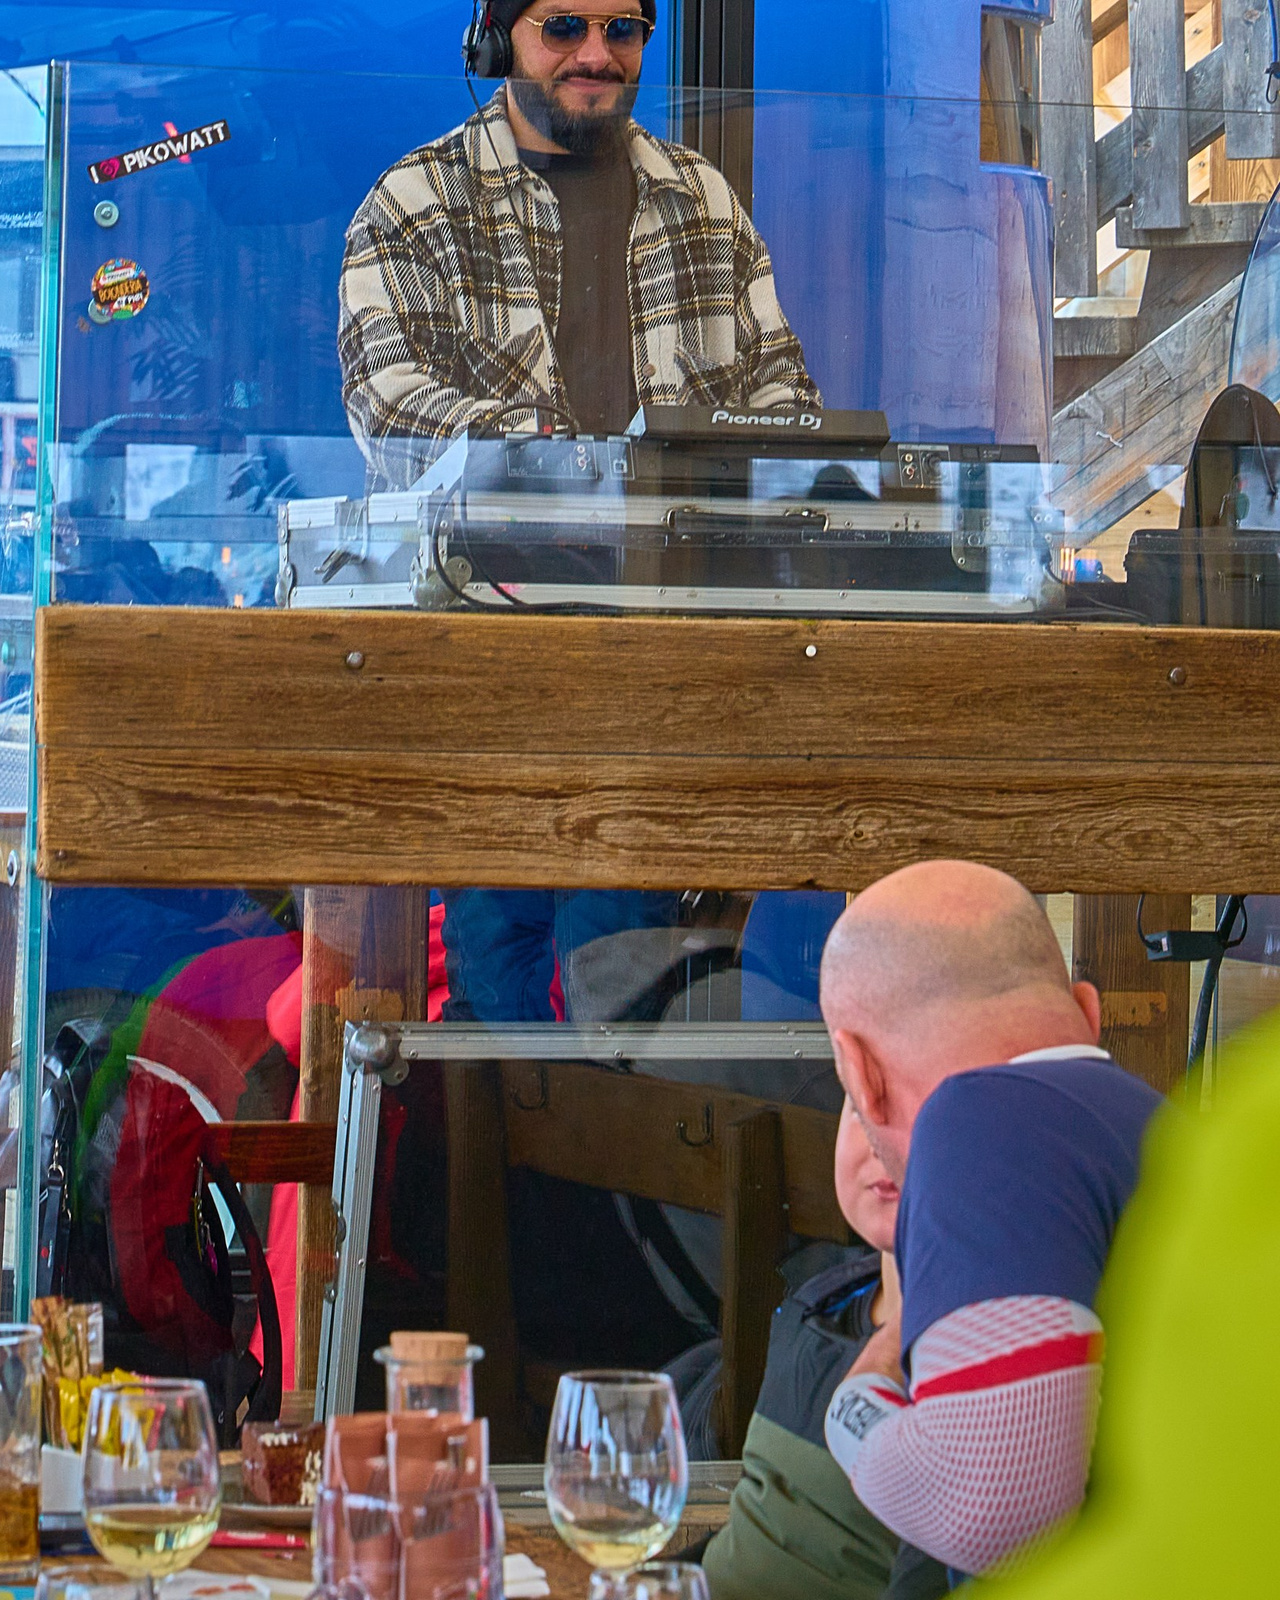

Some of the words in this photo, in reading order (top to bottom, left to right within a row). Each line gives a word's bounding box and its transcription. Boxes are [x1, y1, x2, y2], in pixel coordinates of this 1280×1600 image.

[89, 165, 100, 184] I
[122, 121, 226, 174] PIKOWATT
[711, 409, 795, 426] Pioneer
